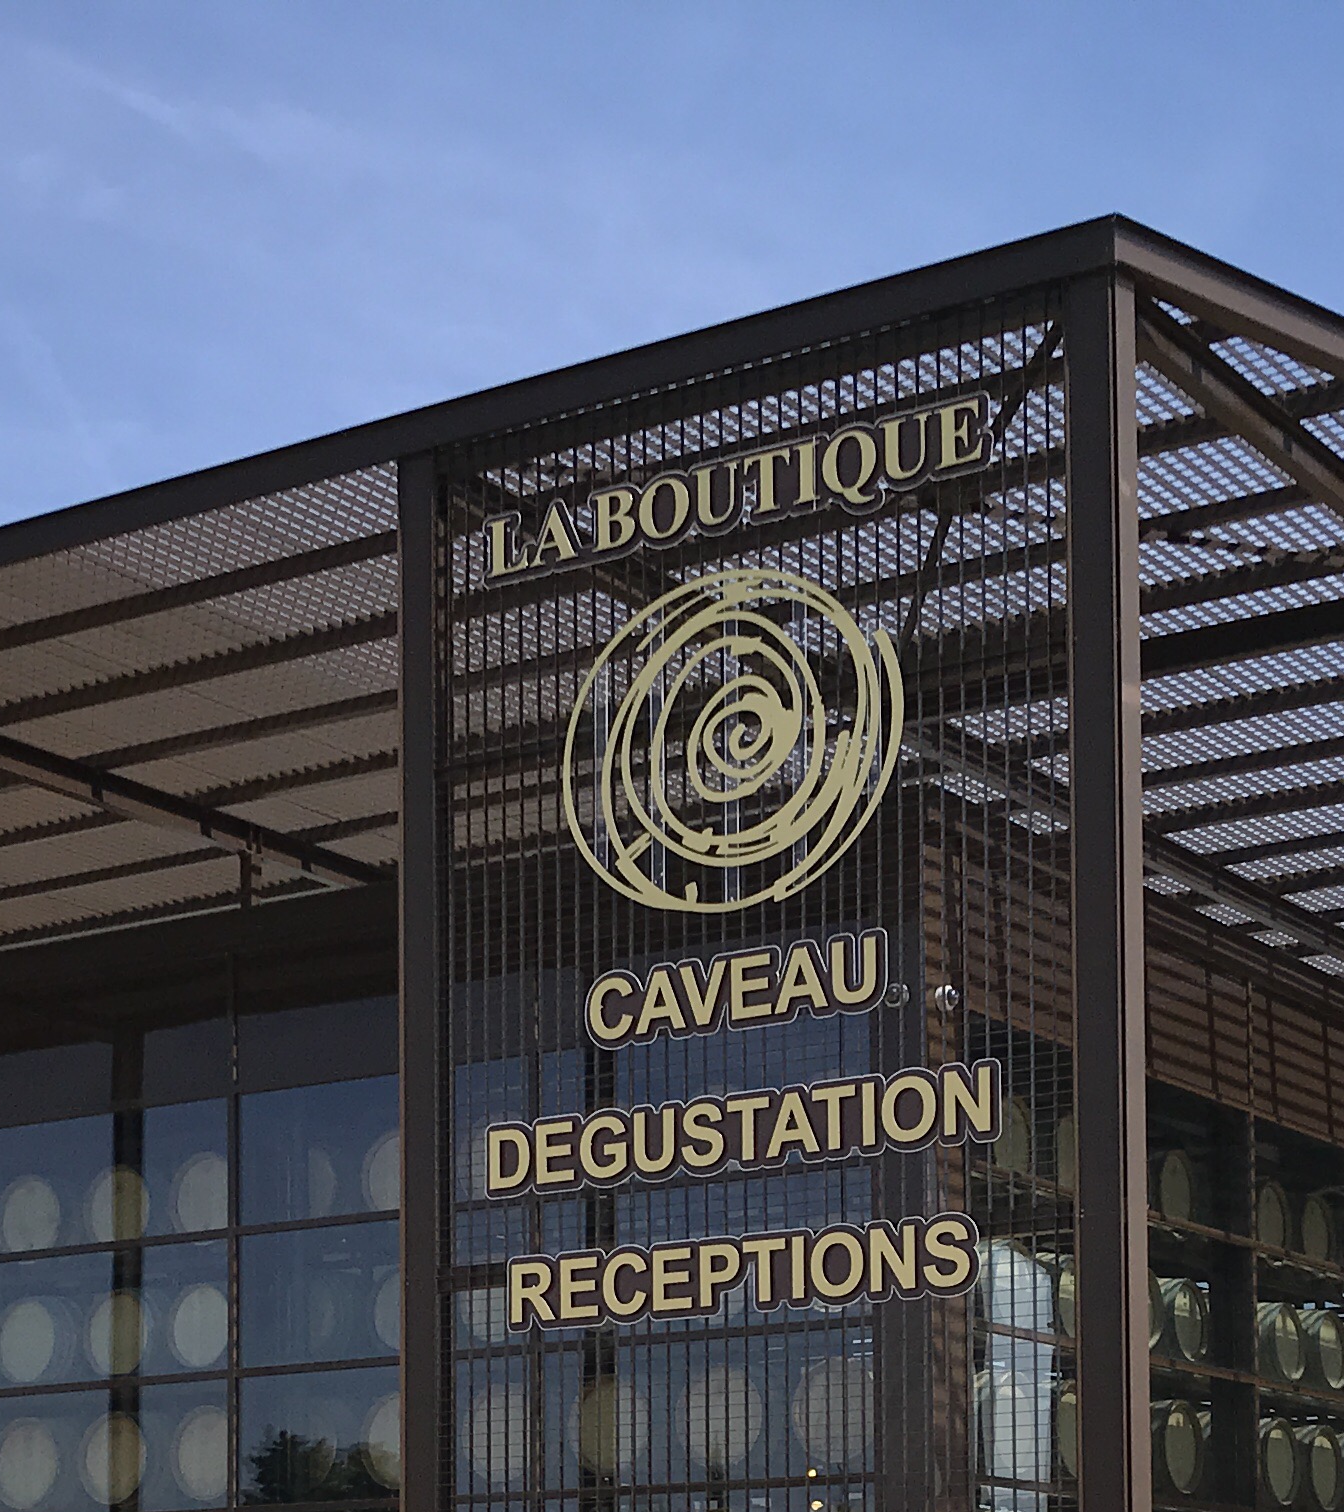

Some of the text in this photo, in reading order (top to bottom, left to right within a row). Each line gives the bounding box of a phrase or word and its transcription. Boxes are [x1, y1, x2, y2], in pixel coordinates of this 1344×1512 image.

[487, 398, 986, 578] LA BOUTIQUE
[588, 936, 879, 1041] CAVEAU
[489, 1066, 993, 1191] DEGUSTATION
[510, 1220, 972, 1325] RECEPTIONS
